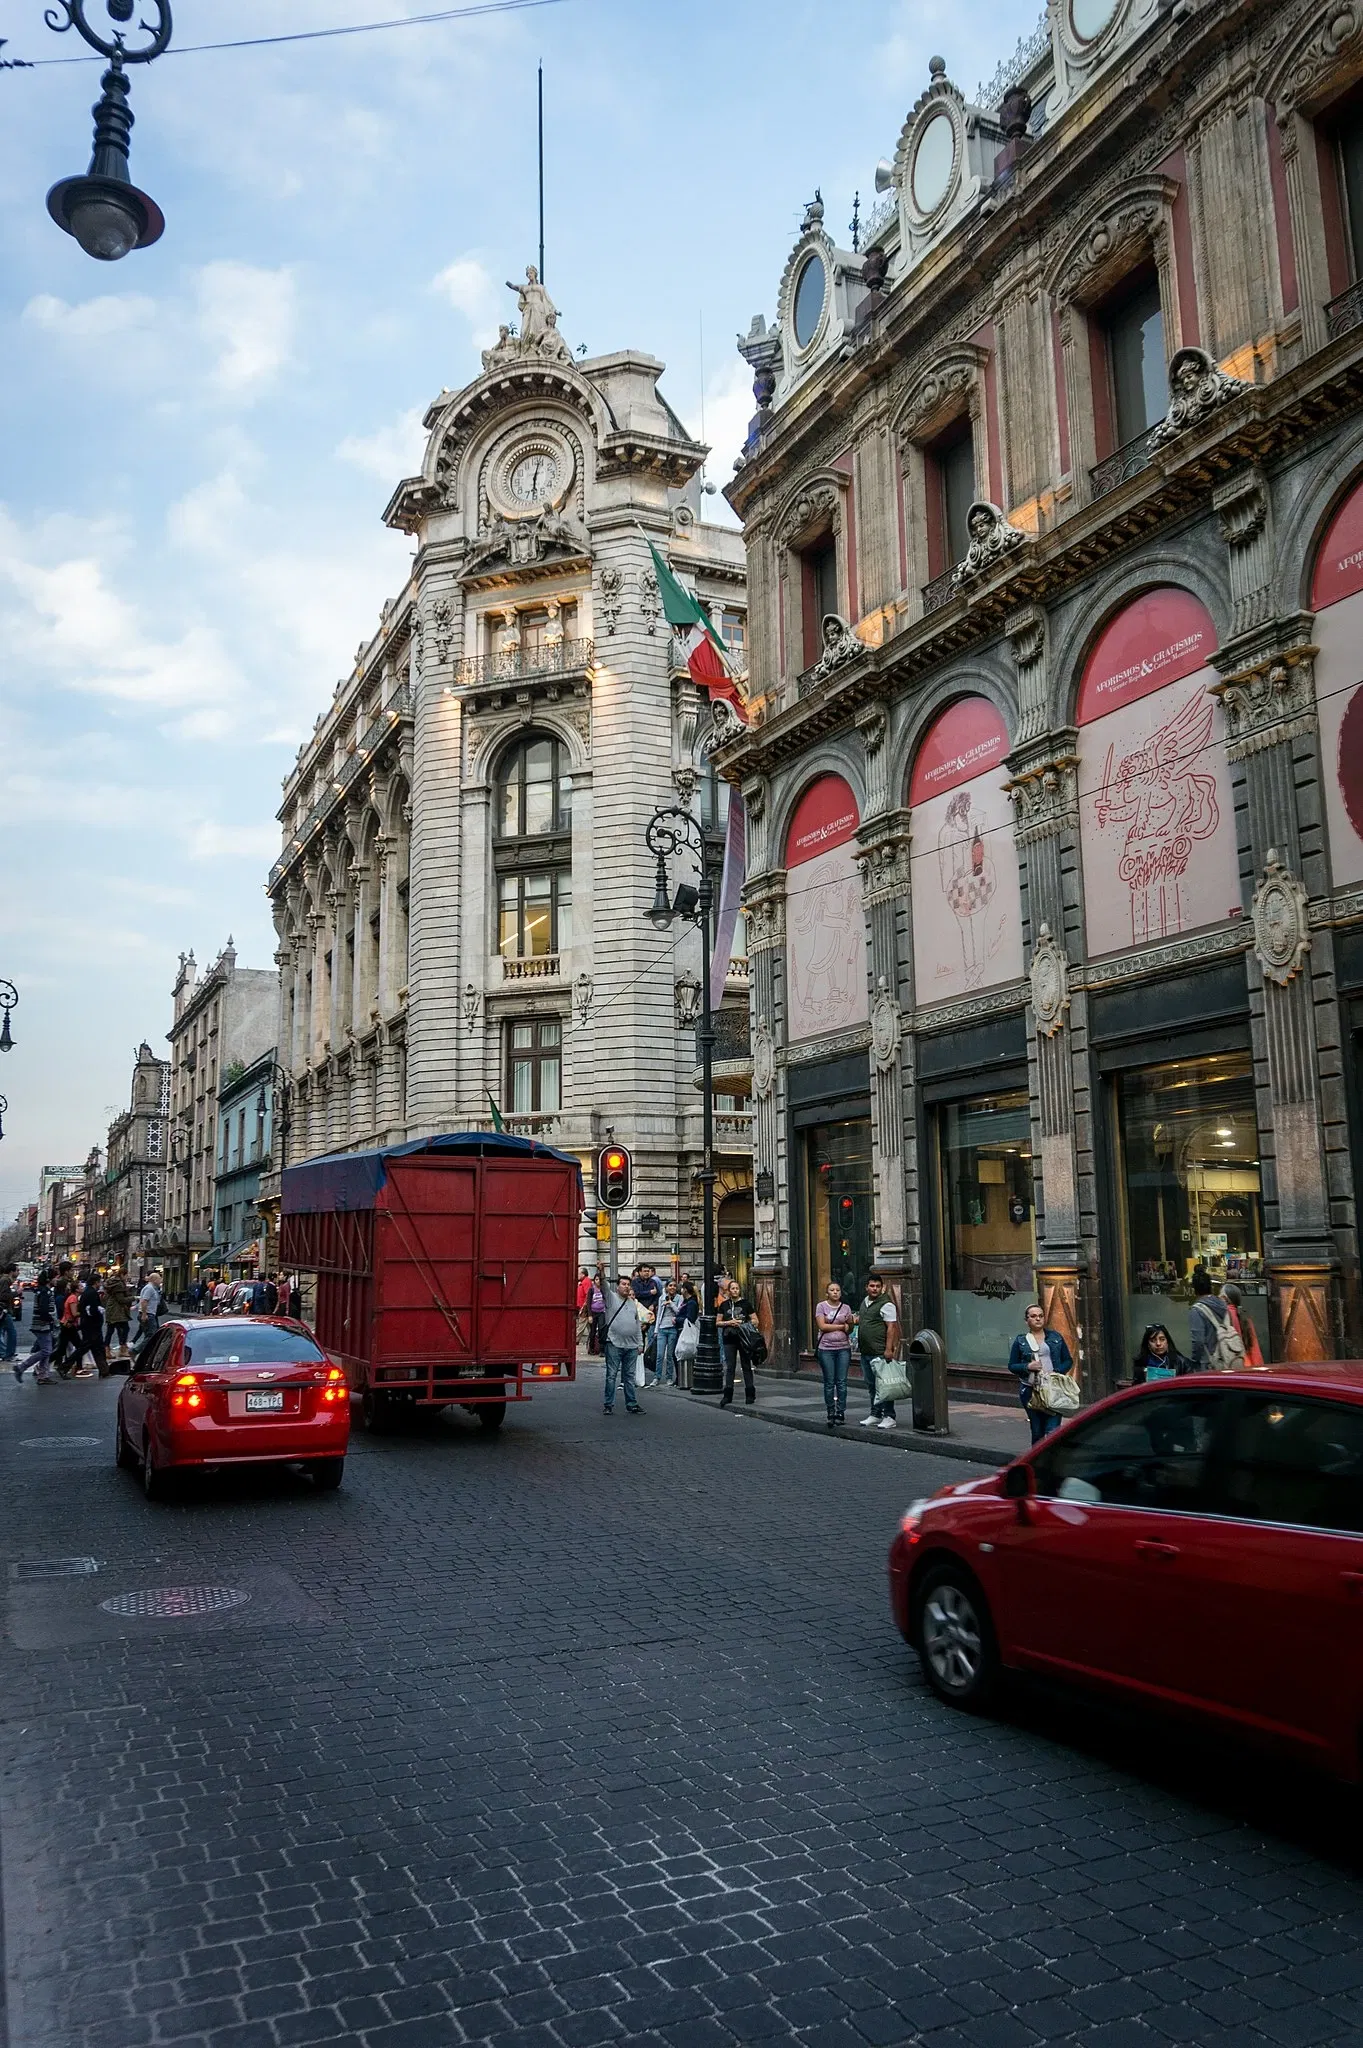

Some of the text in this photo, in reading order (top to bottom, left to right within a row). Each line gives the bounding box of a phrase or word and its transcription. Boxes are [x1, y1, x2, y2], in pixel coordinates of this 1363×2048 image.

[1096, 631, 1203, 694] AFORISMOS & GRAFISMOS
[1153, 658, 1171, 670] Carlos
[924, 735, 1001, 781] AFORISMOS & GRAFISMOS
[820, 826, 828, 840] &
[1212, 1208, 1243, 1217] ZARA
